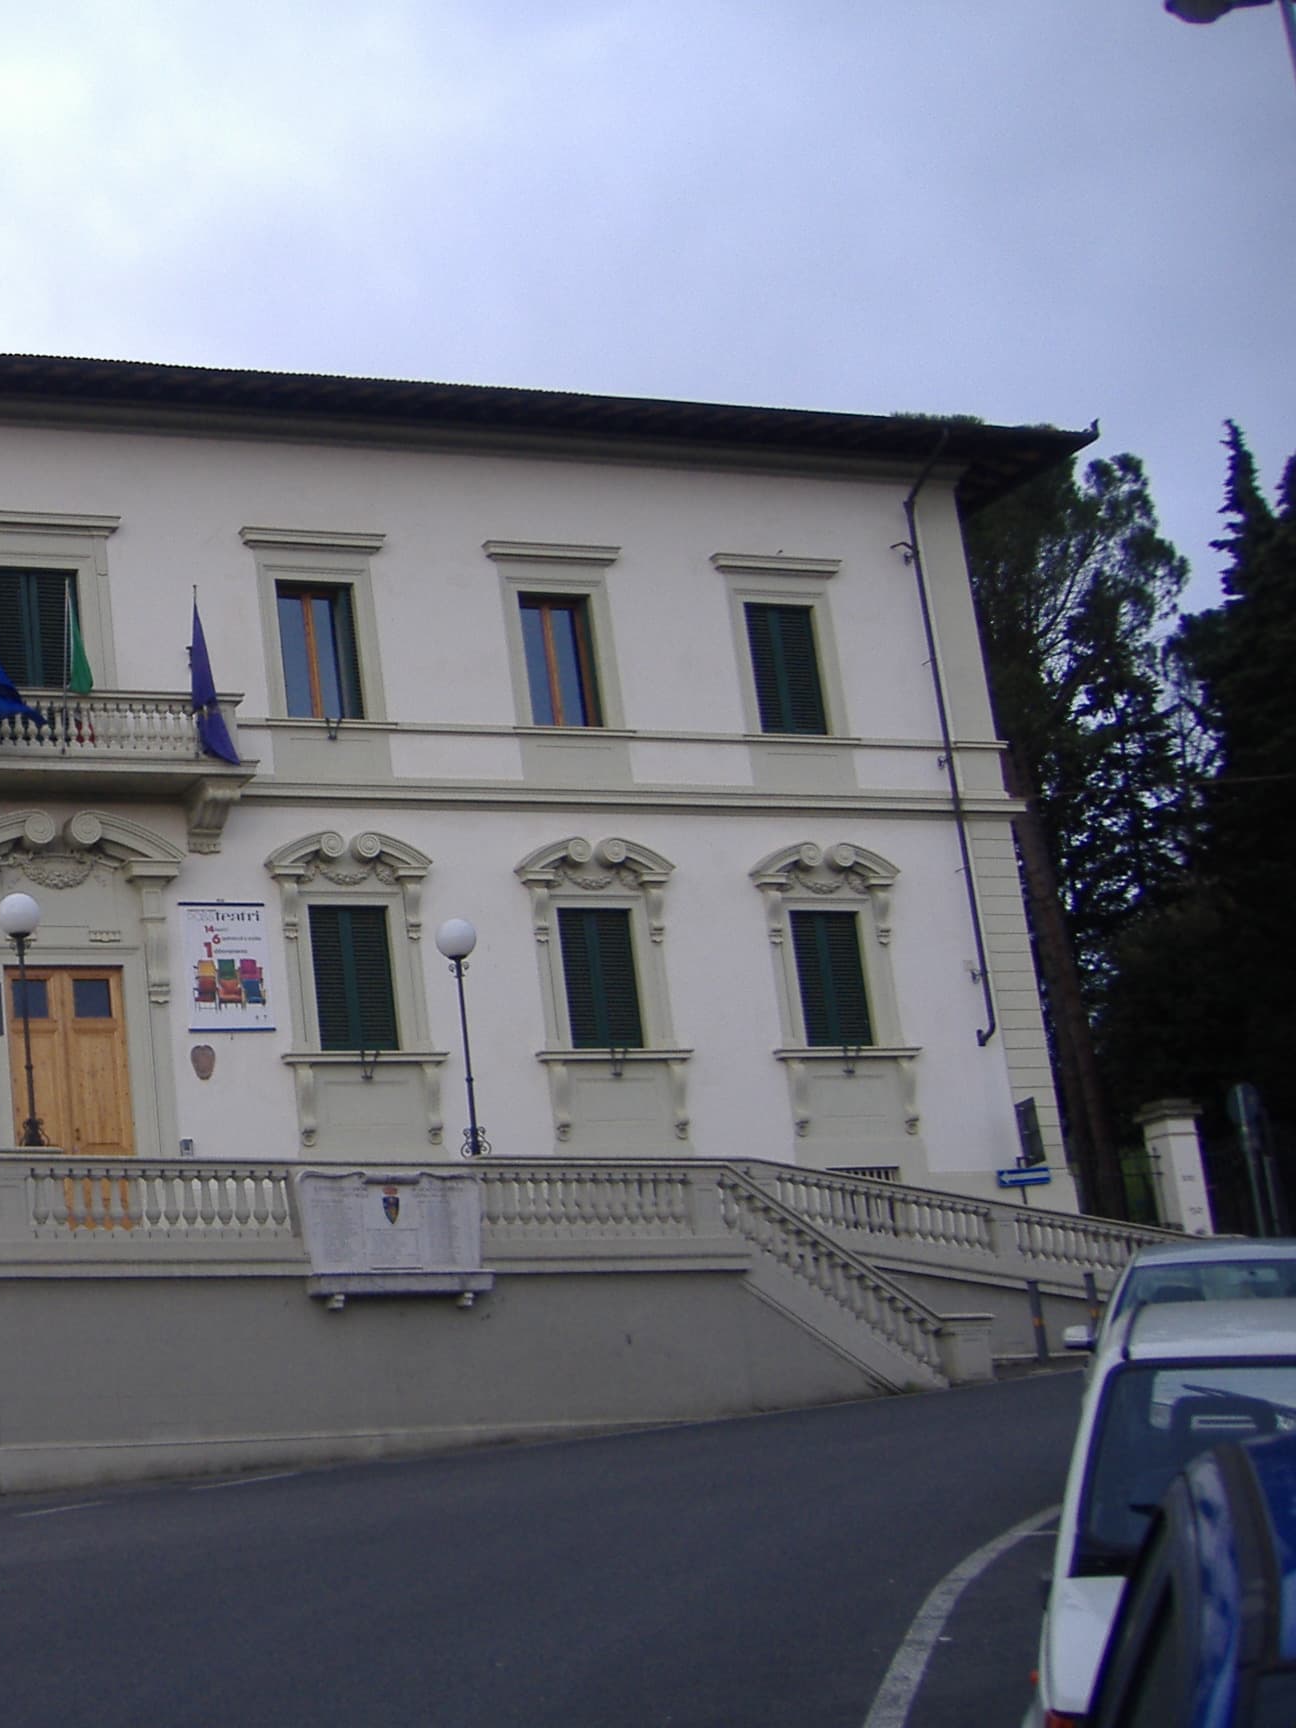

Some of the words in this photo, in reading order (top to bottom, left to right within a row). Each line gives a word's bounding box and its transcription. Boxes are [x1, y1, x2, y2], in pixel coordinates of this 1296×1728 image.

[216, 910, 260, 921] teatri
[204, 925, 214, 933] 14
[212, 934, 221, 944] 6
[204, 942, 213, 958] 1
